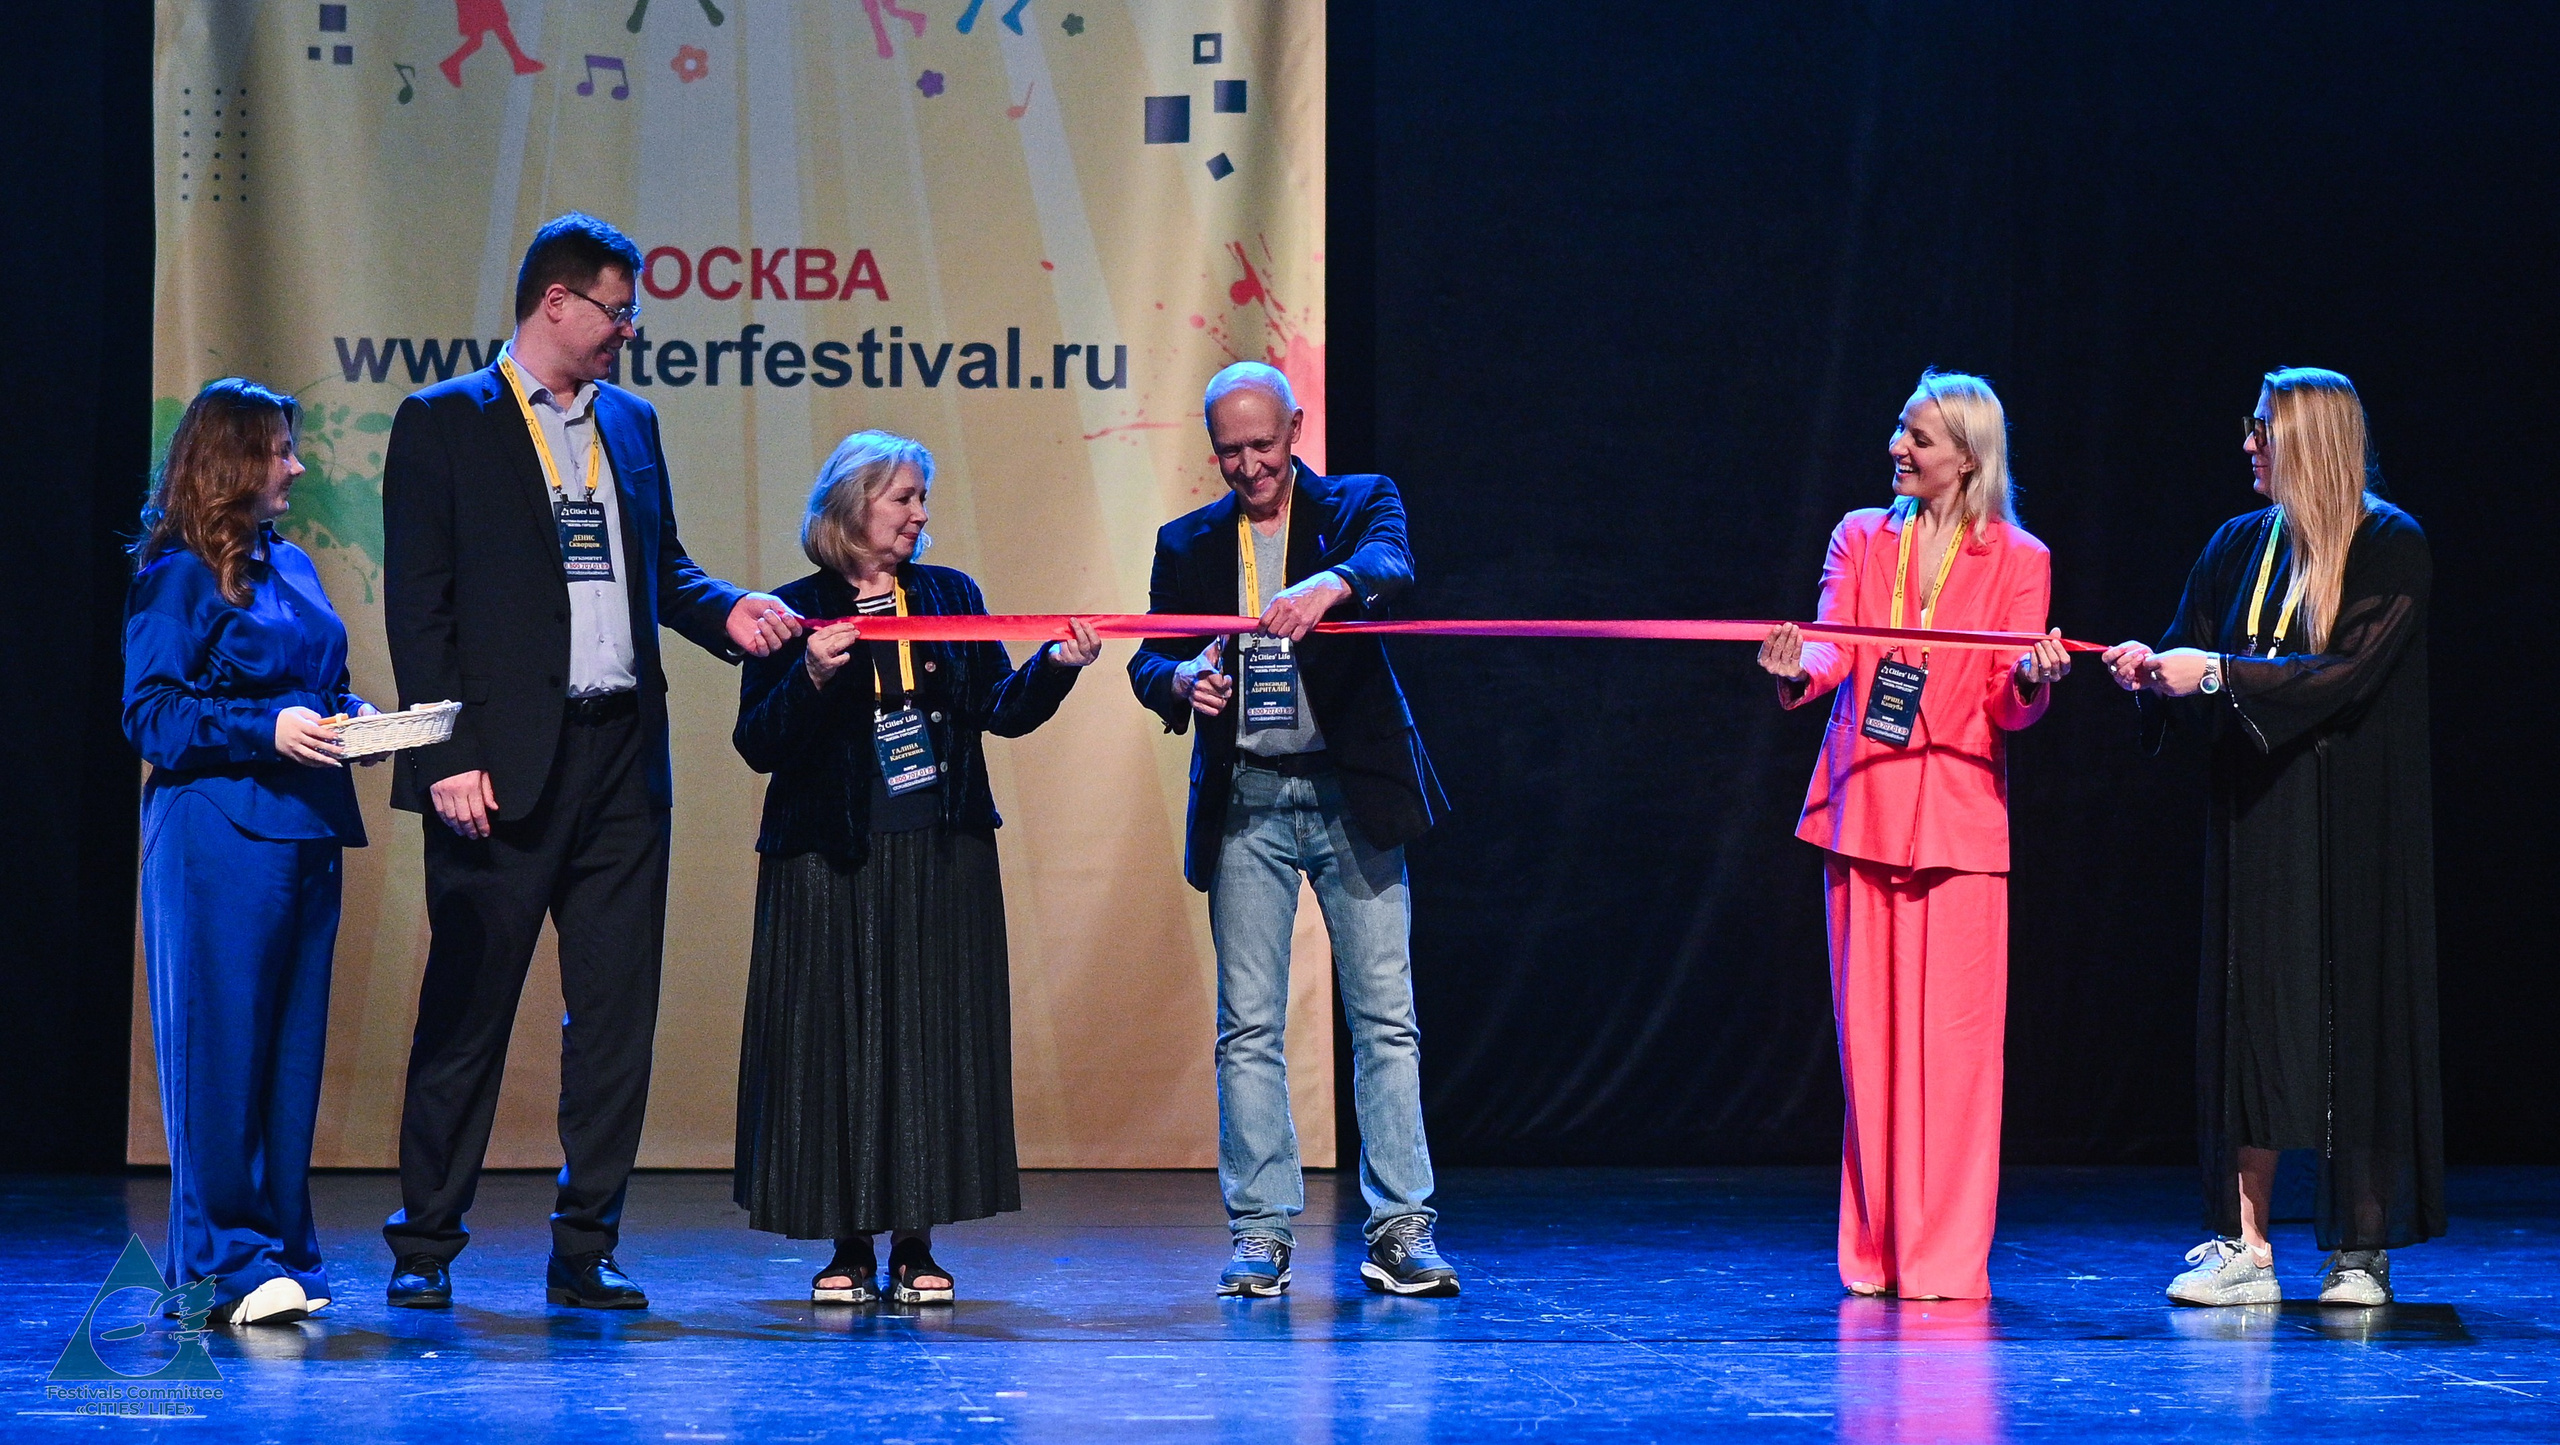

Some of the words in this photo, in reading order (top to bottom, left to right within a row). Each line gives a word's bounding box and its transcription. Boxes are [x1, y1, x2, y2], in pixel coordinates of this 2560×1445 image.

[643, 246, 890, 301] ОСКВА
[334, 323, 1128, 391] wwterfestival.ru
[1278, 653, 1291, 661] Life
[1907, 673, 1920, 682] Life
[905, 714, 918, 723] Life
[892, 742, 919, 755] ГАЛИНА
